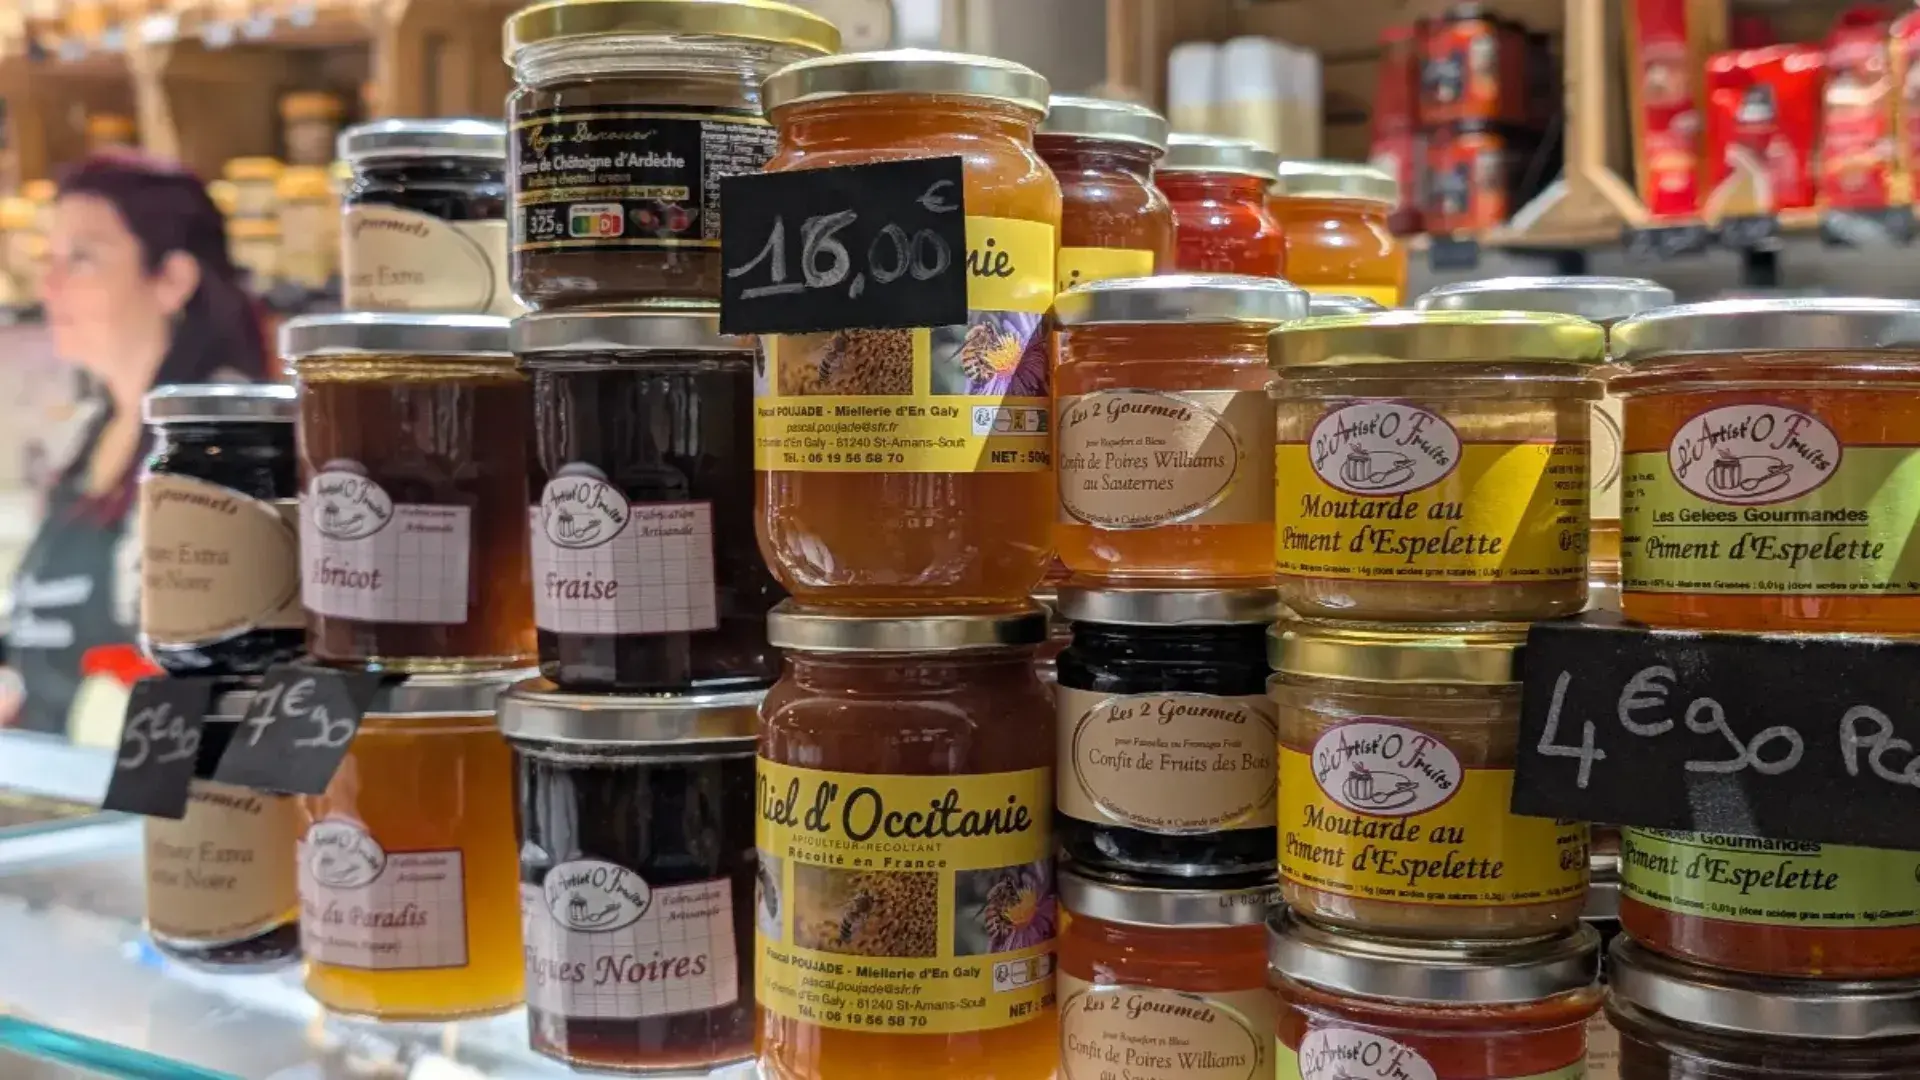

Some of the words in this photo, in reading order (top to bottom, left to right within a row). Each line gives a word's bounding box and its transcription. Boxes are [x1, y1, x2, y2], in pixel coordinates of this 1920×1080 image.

[614, 151, 686, 169] d'Ardèche
[727, 209, 951, 299] 16,00
[917, 180, 959, 213] €
[777, 406, 823, 418] POUJADE
[835, 405, 891, 417] Miellerie
[895, 405, 925, 417] d'En
[931, 405, 959, 419] Galy
[1092, 402, 1101, 417] 2
[1106, 397, 1193, 423] Gourmets
[887, 453, 904, 464] 70
[991, 451, 1017, 464] NET
[1088, 453, 1100, 471] de
[1104, 452, 1149, 472] Poires
[1154, 450, 1225, 469] Williams
[1083, 478, 1099, 493] au
[1102, 473, 1175, 493] Sauternes
[1300, 493, 1419, 520] Moutarde
[1427, 500, 1466, 520] au
[1652, 509, 1674, 522] Les
[1744, 507, 1869, 522] Gourmandes
[1282, 525, 1342, 552] Piment
[1349, 524, 1502, 564] d'Espelette
[1645, 534, 1719, 561] Piment
[1729, 533, 1884, 568] d'Espelette
[1106, 704, 1133, 724] Les
[1139, 702, 1151, 717] 2
[1158, 698, 1247, 725] Gourmets
[1089, 748, 1132, 771] Confit
[1136, 752, 1154, 771] de
[1159, 752, 1207, 772] Fruits
[1212, 752, 1237, 772] des
[804, 780, 1033, 842] d'Occitanie
[1303, 804, 1420, 842] Moutarde
[1429, 824, 1465, 844] au
[788, 846, 845, 865] Récolté
[853, 857, 873, 867] en
[884, 857, 948, 869] France
[1286, 831, 1346, 868] Piment
[1352, 845, 1504, 887] d'Espelette
[1624, 840, 1679, 876] Piment
[1685, 853, 1839, 895] d'Espelette
[594, 950, 708, 986] Noires
[791, 955, 844, 975] POUJADE
[856, 965, 915, 980] Miellerie
[919, 967, 949, 979] d'En
[953, 965, 981, 979] Galy
[821, 993, 846, 1009] Galy
[857, 999, 892, 1011] 81240
[1009, 1000, 1033, 1018] NET
[1082, 995, 1105, 1013] Les
[1109, 995, 1120, 1011] 2
[1125, 994, 1216, 1024] Gourmets
[847, 1013, 862, 1024] 19
[910, 1015, 928, 1027] 70
[1067, 1033, 1101, 1060] Confit
[1104, 1044, 1121, 1064] de
[1125, 1047, 1172, 1069] Poires
[1176, 1051, 1246, 1069] Williams
